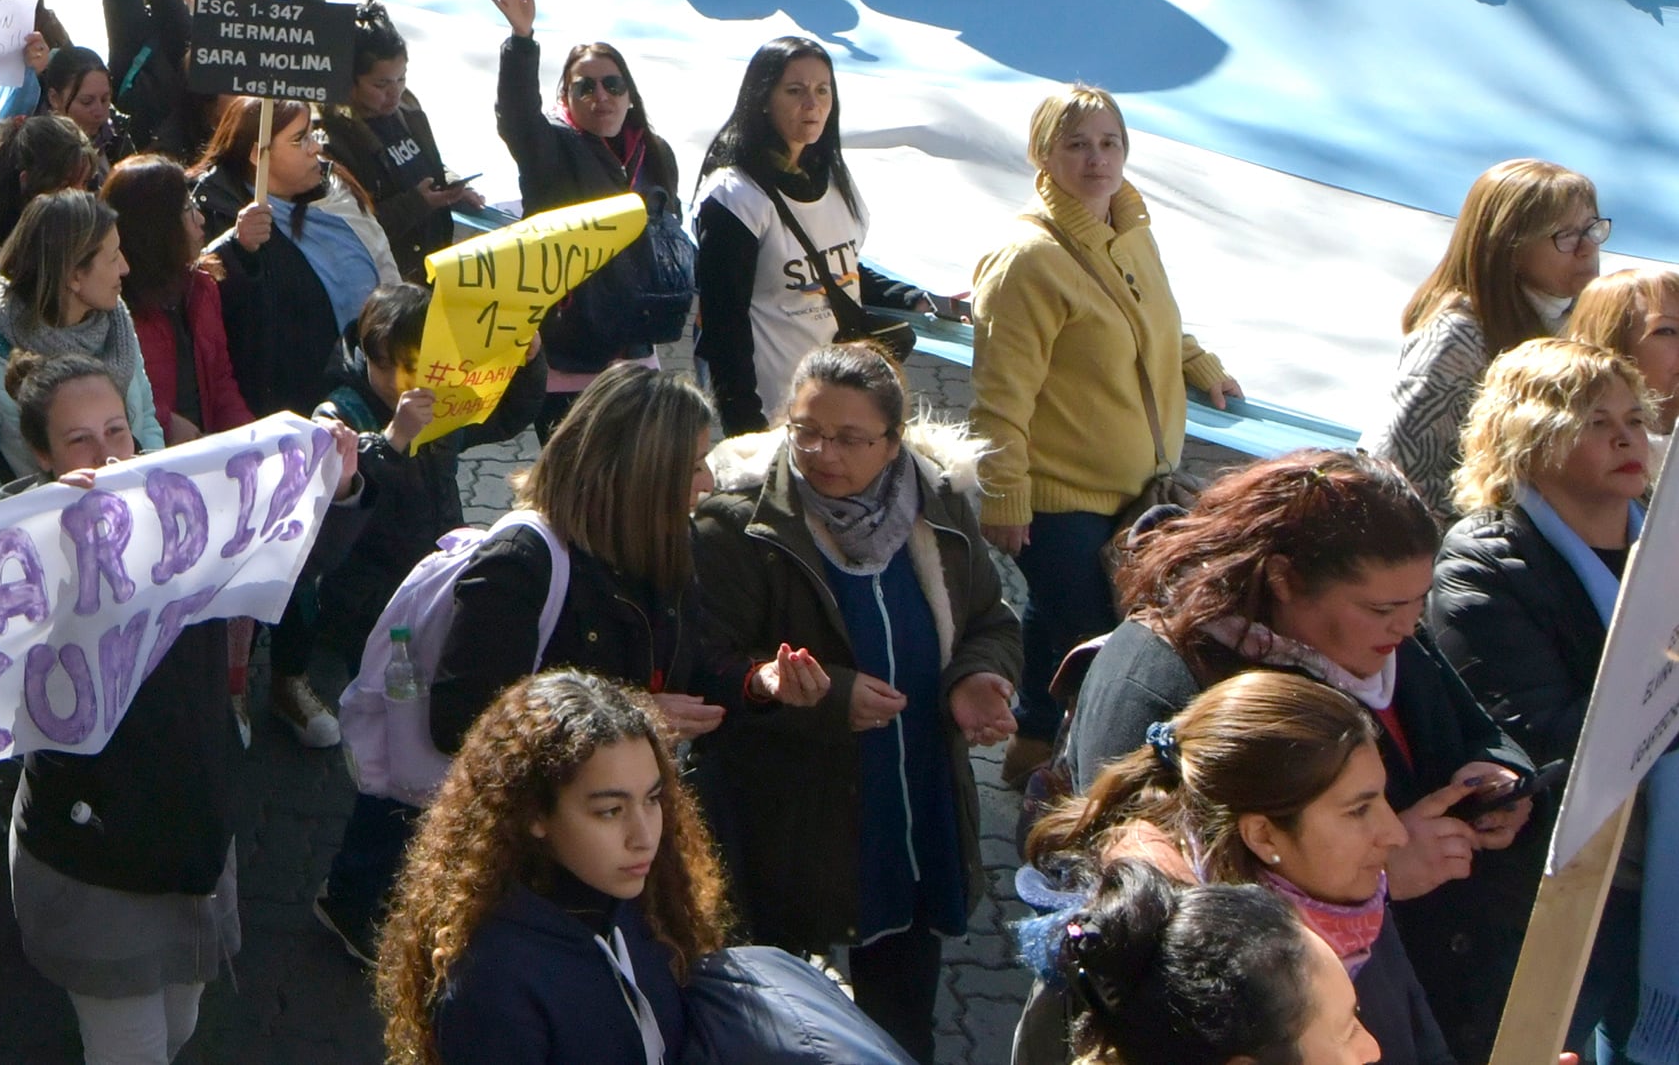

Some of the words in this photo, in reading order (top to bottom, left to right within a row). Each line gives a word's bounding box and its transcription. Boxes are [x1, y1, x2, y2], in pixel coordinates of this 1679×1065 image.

[220, 22, 316, 46] HERMANA
[196, 47, 248, 67] SARA
[259, 52, 333, 72] MOLINA
[232, 76, 267, 95] Las
[273, 80, 328, 102] Heras
[457, 246, 497, 290] EN
